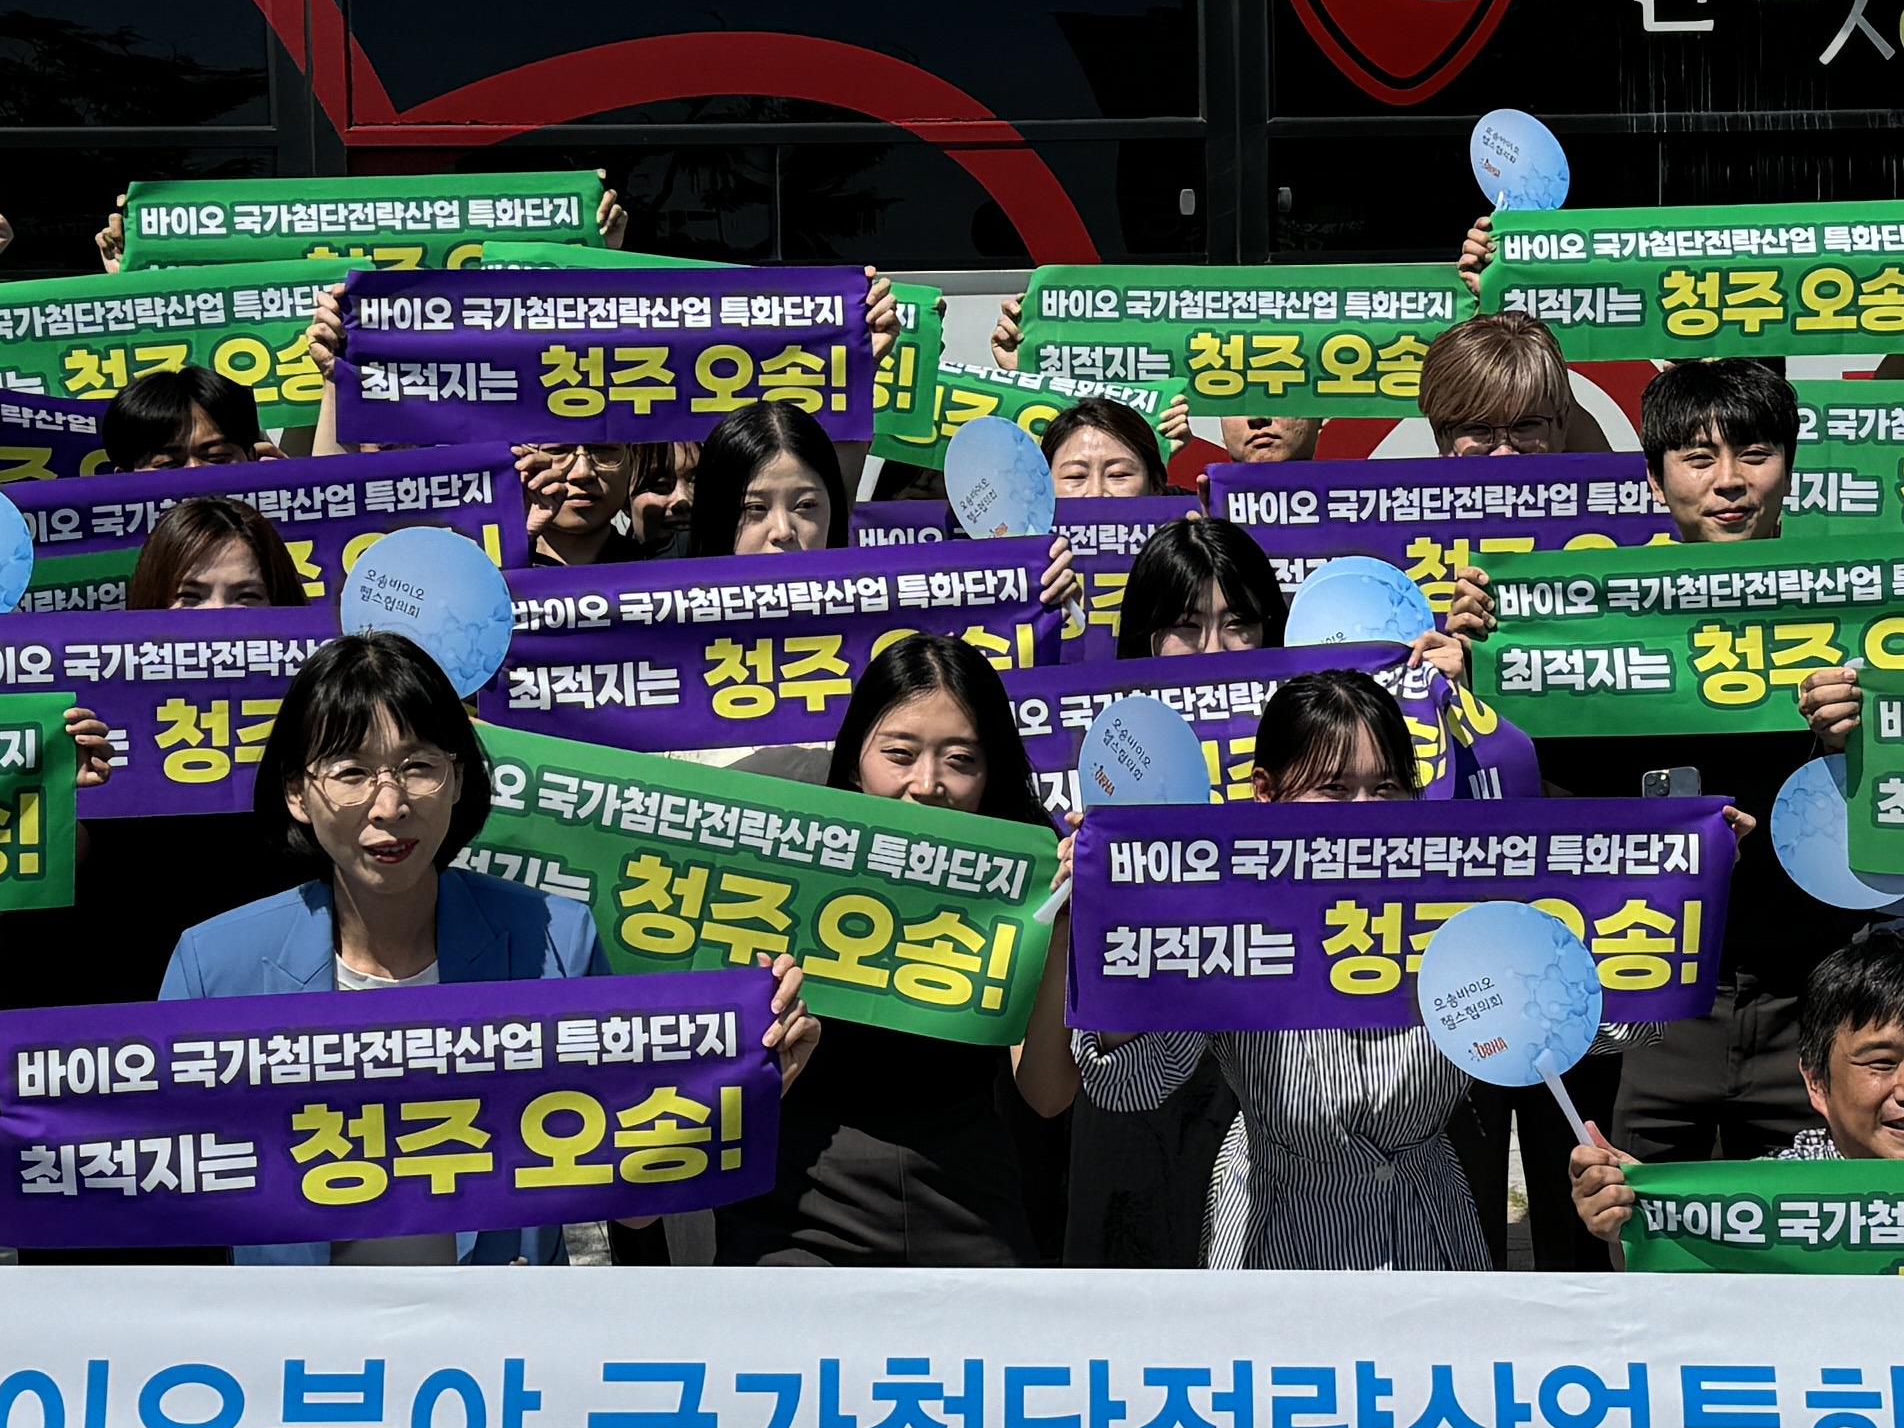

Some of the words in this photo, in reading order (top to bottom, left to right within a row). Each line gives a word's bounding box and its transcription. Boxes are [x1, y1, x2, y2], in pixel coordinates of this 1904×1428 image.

[141, 206, 226, 235] 바이오
[234, 200, 460, 233] 국가첨단전략산업
[468, 197, 579, 228] 특화단지
[1505, 234, 1586, 260] 바이오
[1593, 227, 1816, 258] 국가첨단전략산업
[361, 298, 454, 330] 바이오
[462, 297, 711, 330] 국가첨단전략산업
[720, 296, 843, 327] 특화단지
[1043, 290, 1119, 318] 바이오
[1126, 290, 1337, 319] 국가첨단전략산업
[1345, 291, 1452, 319] 특화단지
[1504, 288, 1642, 324] 최적지는
[1662, 271, 1783, 335] 청주
[361, 362, 518, 401] 최적지는
[540, 345, 676, 417] 청주
[691, 345, 846, 413] 오송!
[1028, 345, 1170, 390] 최적지는
[1189, 333, 1305, 395] 청주
[365, 471, 492, 512] 특화단지
[1228, 491, 1319, 524] 바이오
[1328, 483, 1577, 522] 국가첨단전략산업
[511, 595, 608, 630] 바이오
[619, 577, 888, 624] 국가첨단전략산업
[897, 568, 1027, 608] 특화단지
[1498, 581, 1598, 616] 바이오
[1608, 565, 1882, 610] 국가첨단전략산업
[509, 662, 680, 709] 최적지는
[704, 635, 852, 718] 청주
[1502, 648, 1670, 691] 최적지는
[539, 772, 860, 870] 국가첨단전략산업
[868, 834, 1027, 899] 특화단지
[1110, 840, 1219, 883] 바이오
[1232, 836, 1537, 880] 국가첨단전략산업
[1547, 834, 1699, 875] 특화단지
[619, 855, 796, 975] 청주
[791, 895, 1016, 1009] 오송!
[1103, 924, 1295, 978] 최적지는
[1432, 975, 1497, 1014] 오송바이오
[18, 1045, 158, 1096] 바이오
[171, 1022, 542, 1087] 국가첨단전략산업
[556, 1012, 736, 1065] 특화단지
[21, 1133, 257, 1195] 최적지는
[290, 1099, 493, 1205] 청주
[515, 1086, 741, 1188] 오송!
[1641, 1200, 1765, 1243] 바이오
